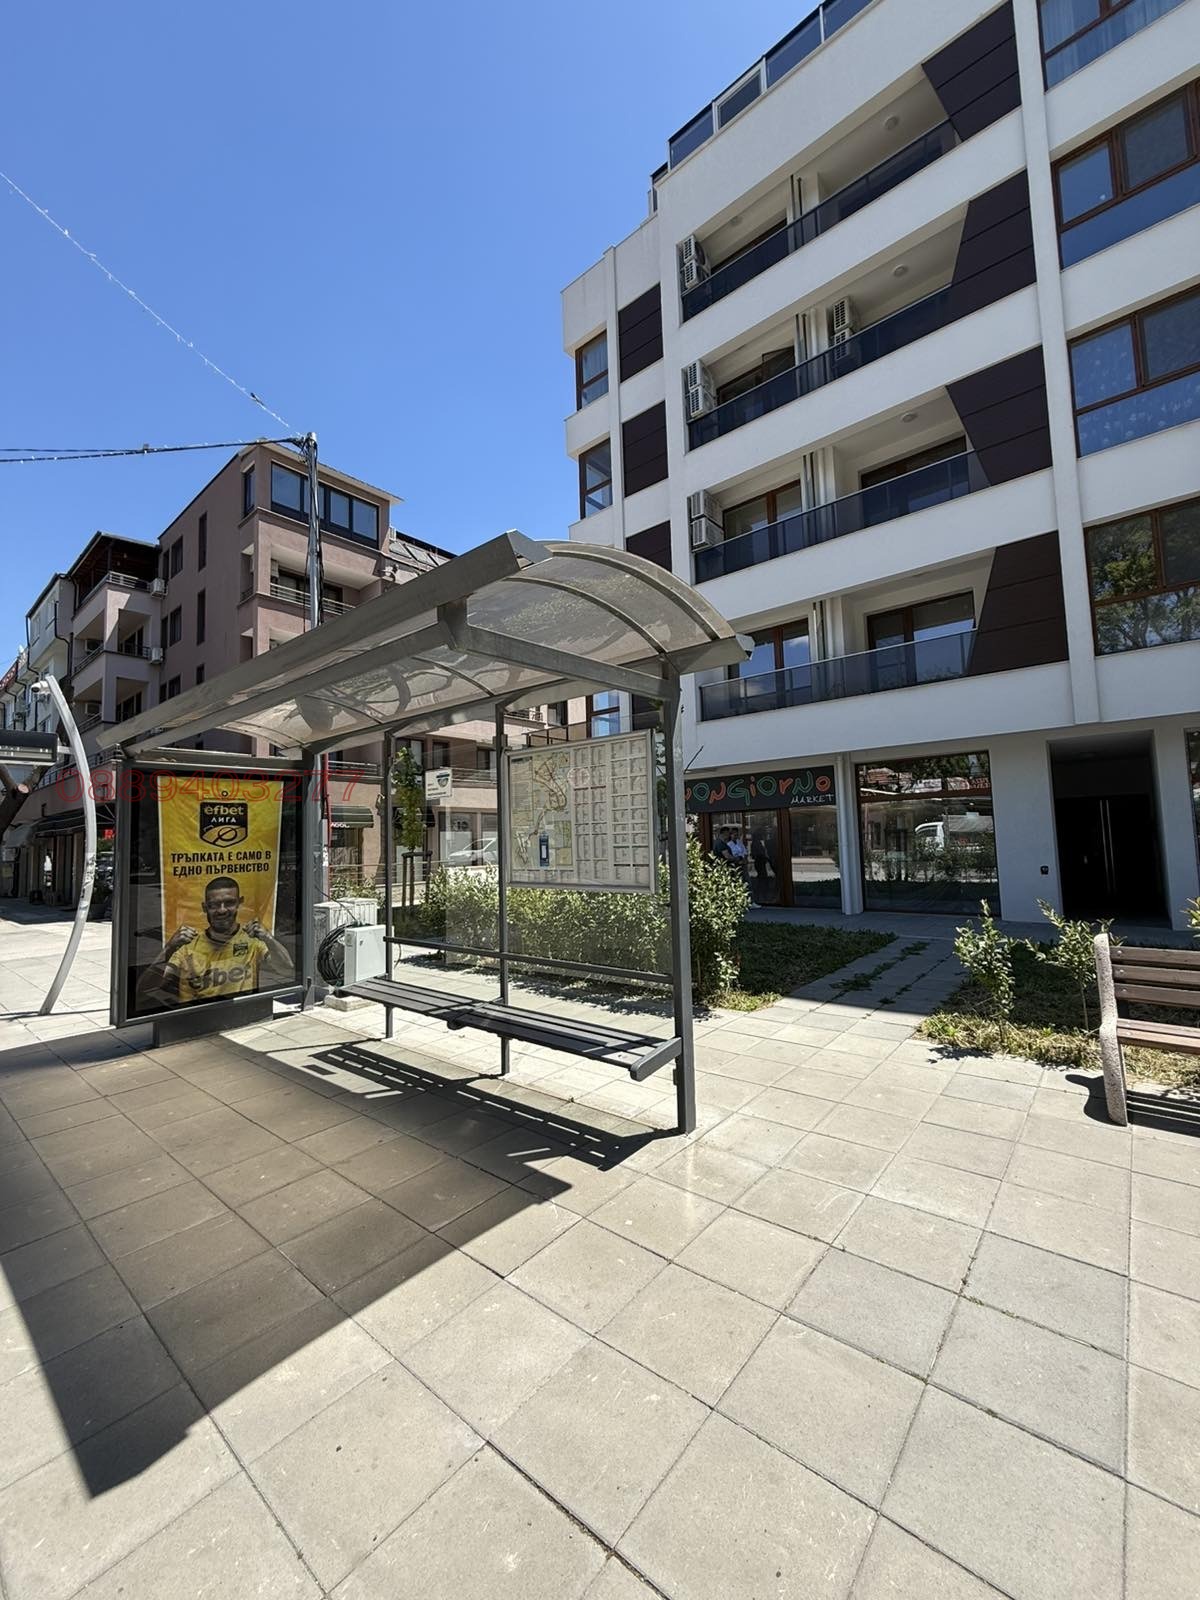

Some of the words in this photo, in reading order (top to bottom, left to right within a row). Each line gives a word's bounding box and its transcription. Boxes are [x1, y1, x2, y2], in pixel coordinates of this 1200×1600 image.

[790, 793, 835, 805] MARKET
[204, 805, 245, 815] efbet
[171, 852, 225, 863] ТРЪПКАТА
[236, 851, 262, 861] САМО
[173, 865, 202, 878] ЕДНО
[206, 862, 270, 875] ПЪРВЕНСТВО
